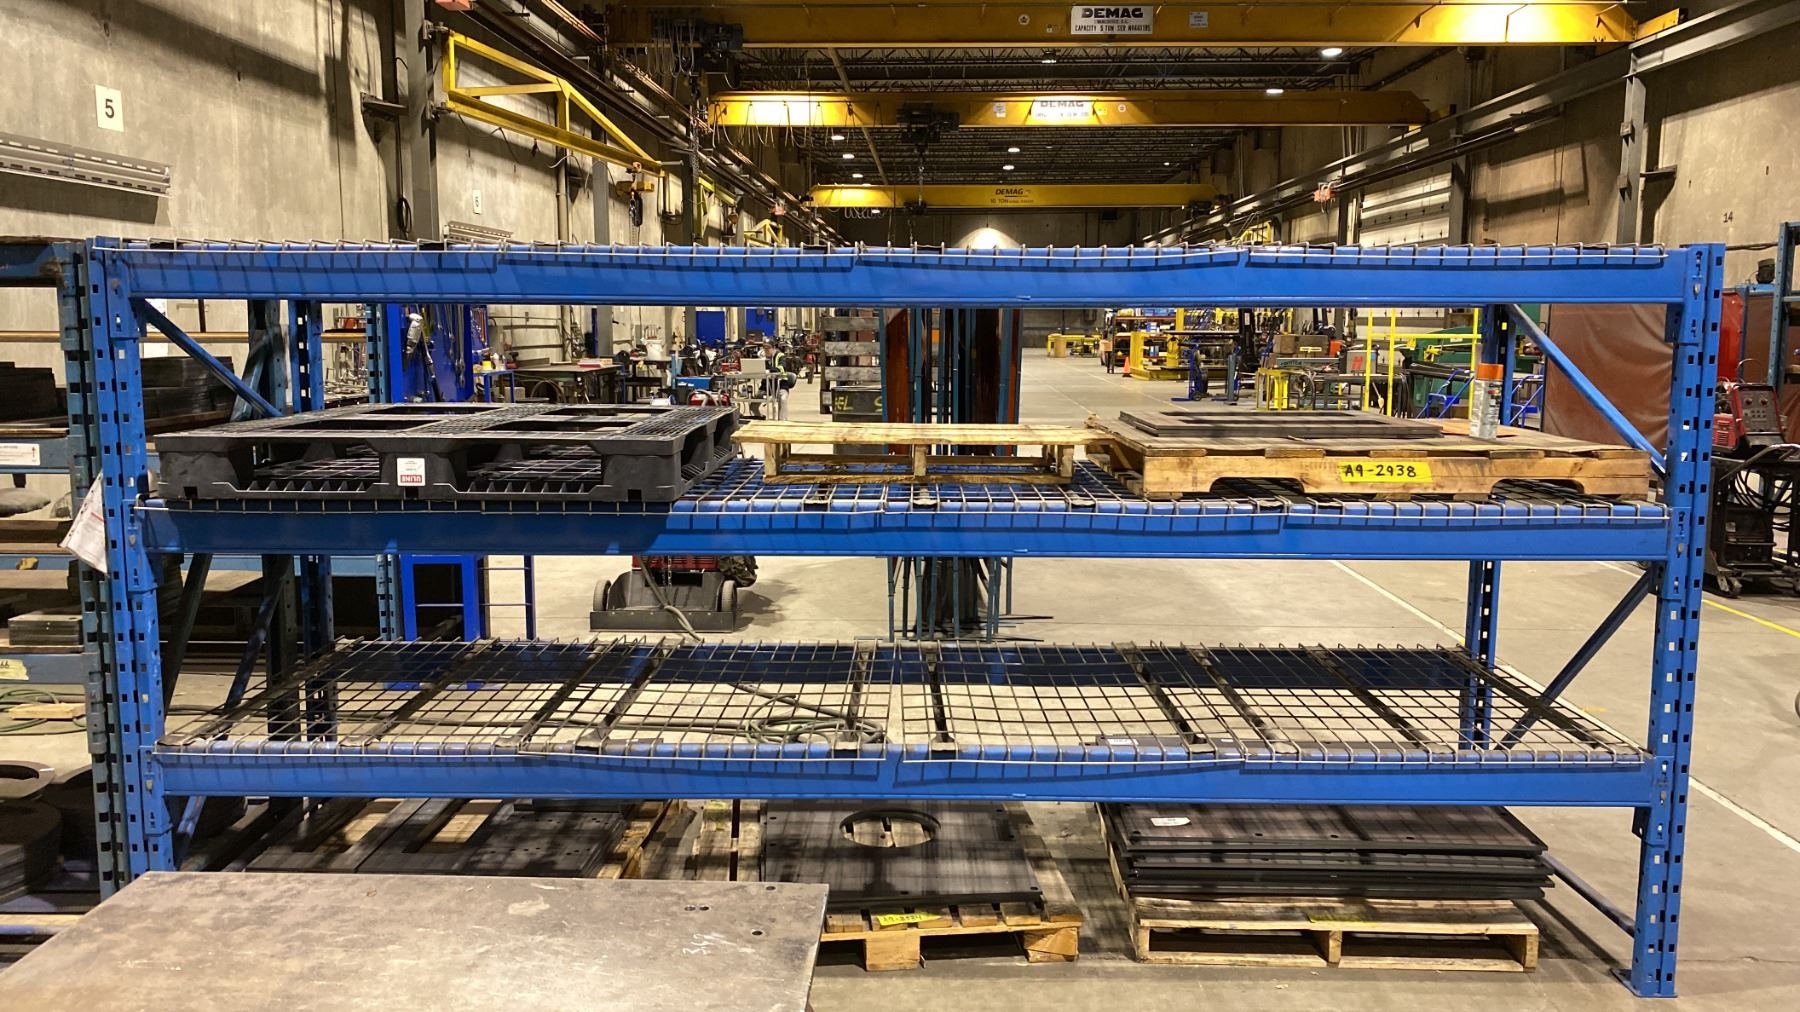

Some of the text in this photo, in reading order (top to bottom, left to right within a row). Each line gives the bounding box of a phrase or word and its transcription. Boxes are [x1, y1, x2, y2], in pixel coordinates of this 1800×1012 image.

[1081, 7, 1144, 19] DEMAG
[1074, 24, 1097, 32] CAPACITY
[1105, 24, 1114, 32] TON
[105, 98, 115, 119] 5
[1344, 463, 1417, 478] A9-2938
